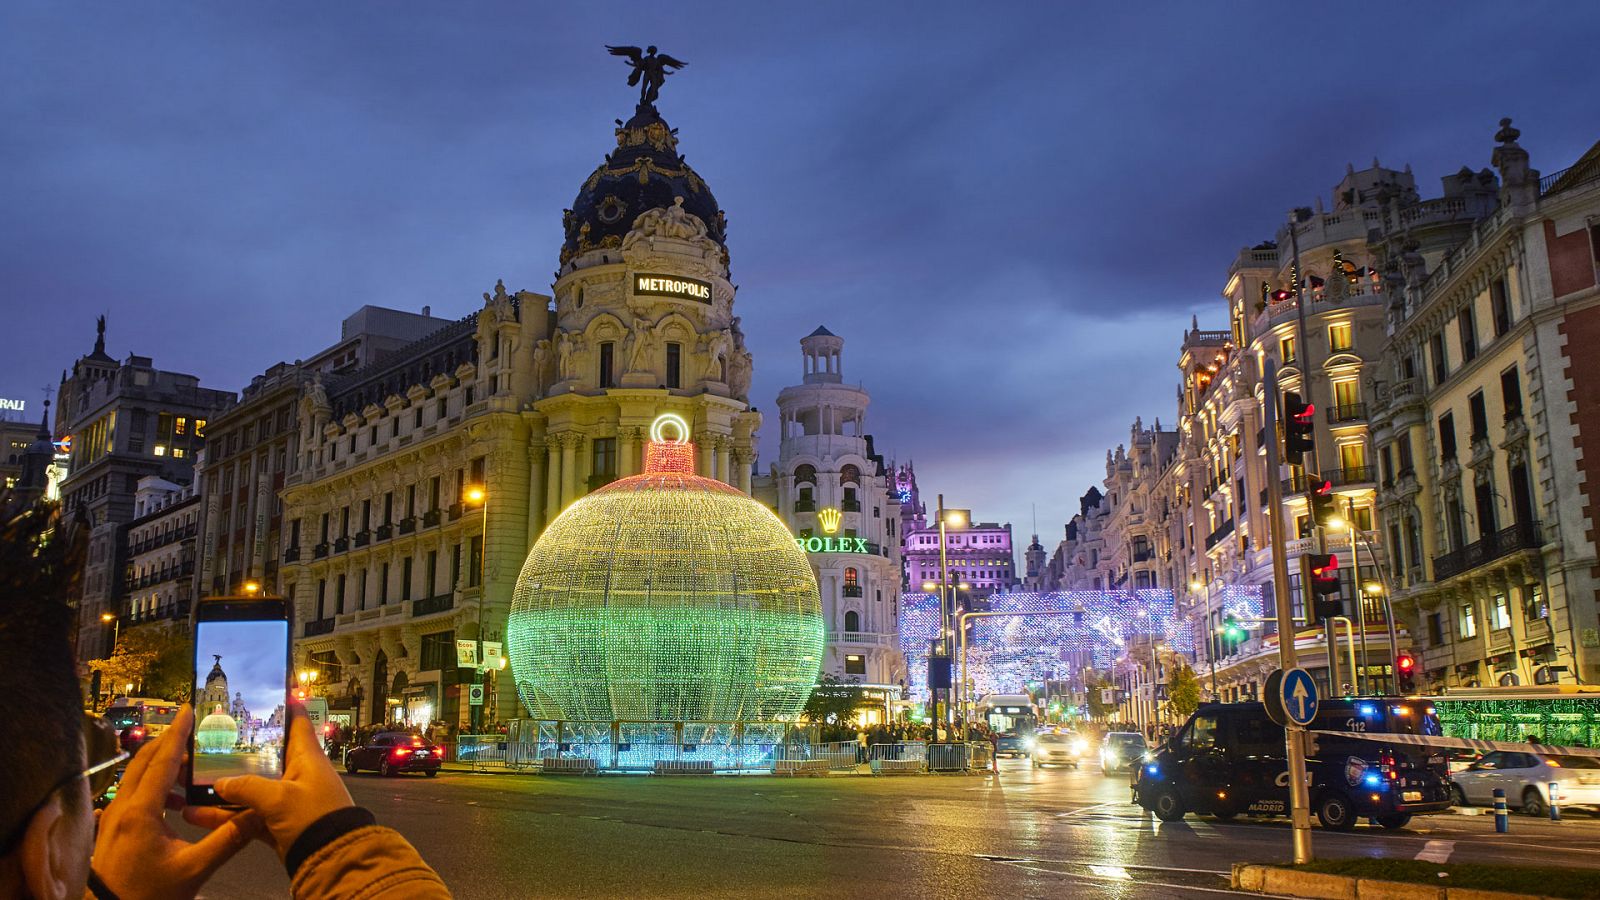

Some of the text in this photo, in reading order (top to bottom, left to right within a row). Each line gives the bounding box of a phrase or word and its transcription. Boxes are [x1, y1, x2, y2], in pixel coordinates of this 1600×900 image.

[639, 278, 710, 299] METROPOLIS
[1350, 721, 1366, 732] 112
[1248, 804, 1285, 812] MADRID
